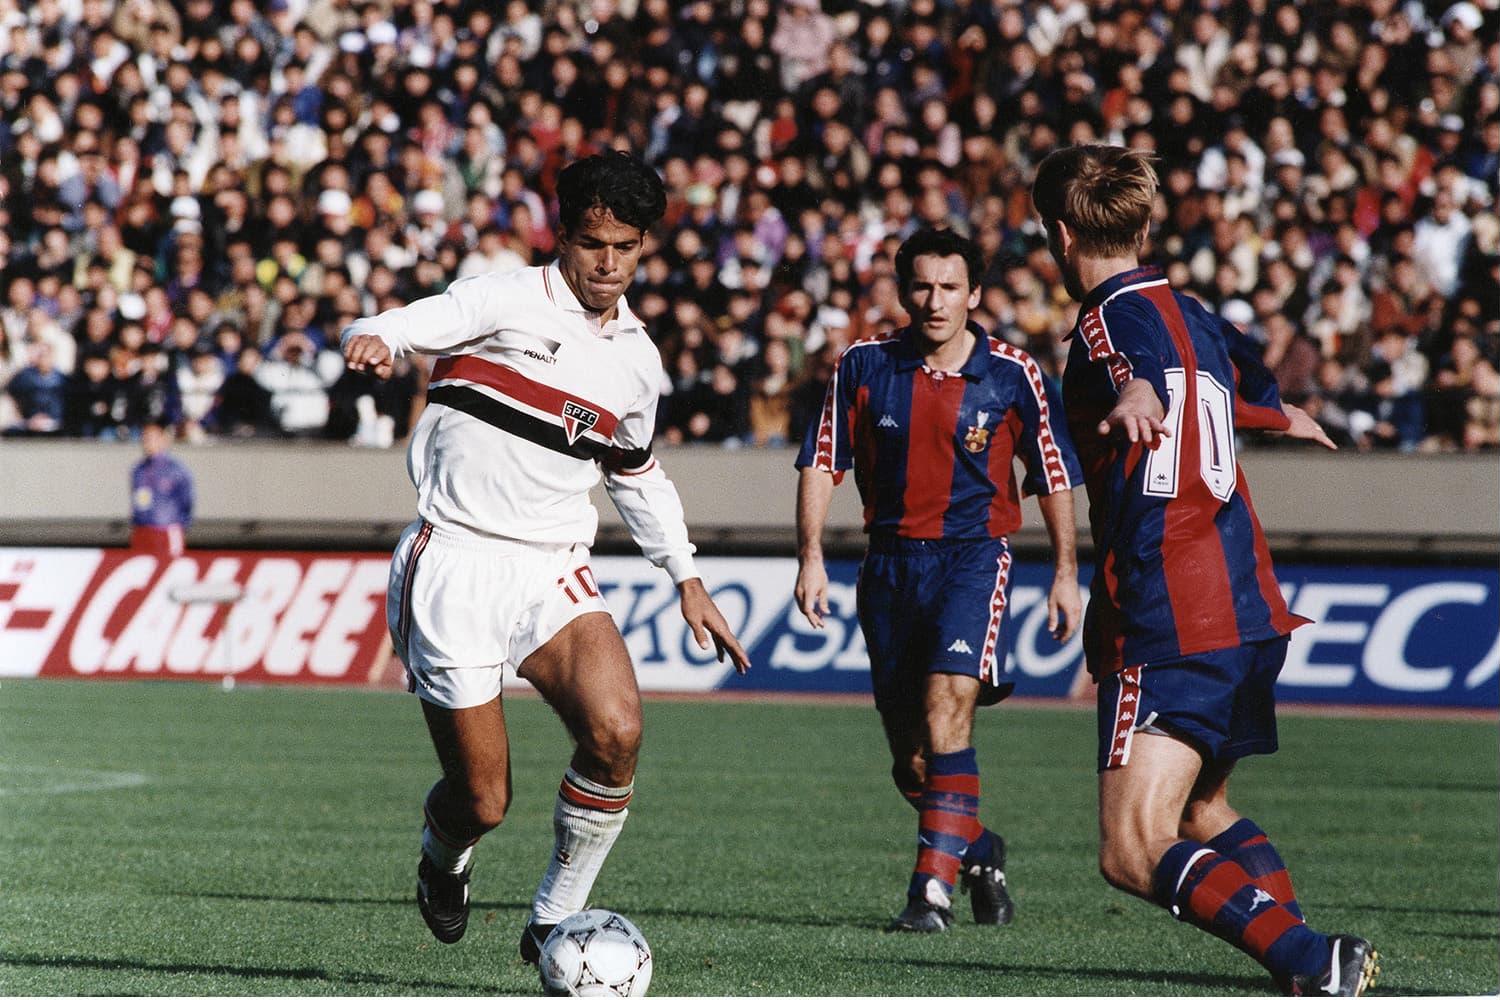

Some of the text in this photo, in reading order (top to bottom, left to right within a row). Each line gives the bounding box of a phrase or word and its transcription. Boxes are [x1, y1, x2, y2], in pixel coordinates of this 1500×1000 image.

[523, 348, 557, 366] PENALTY
[565, 403, 596, 424] SPFC
[1142, 366, 1237, 503] 10
[557, 564, 600, 605] 10
[68, 554, 391, 677] CALBEE
